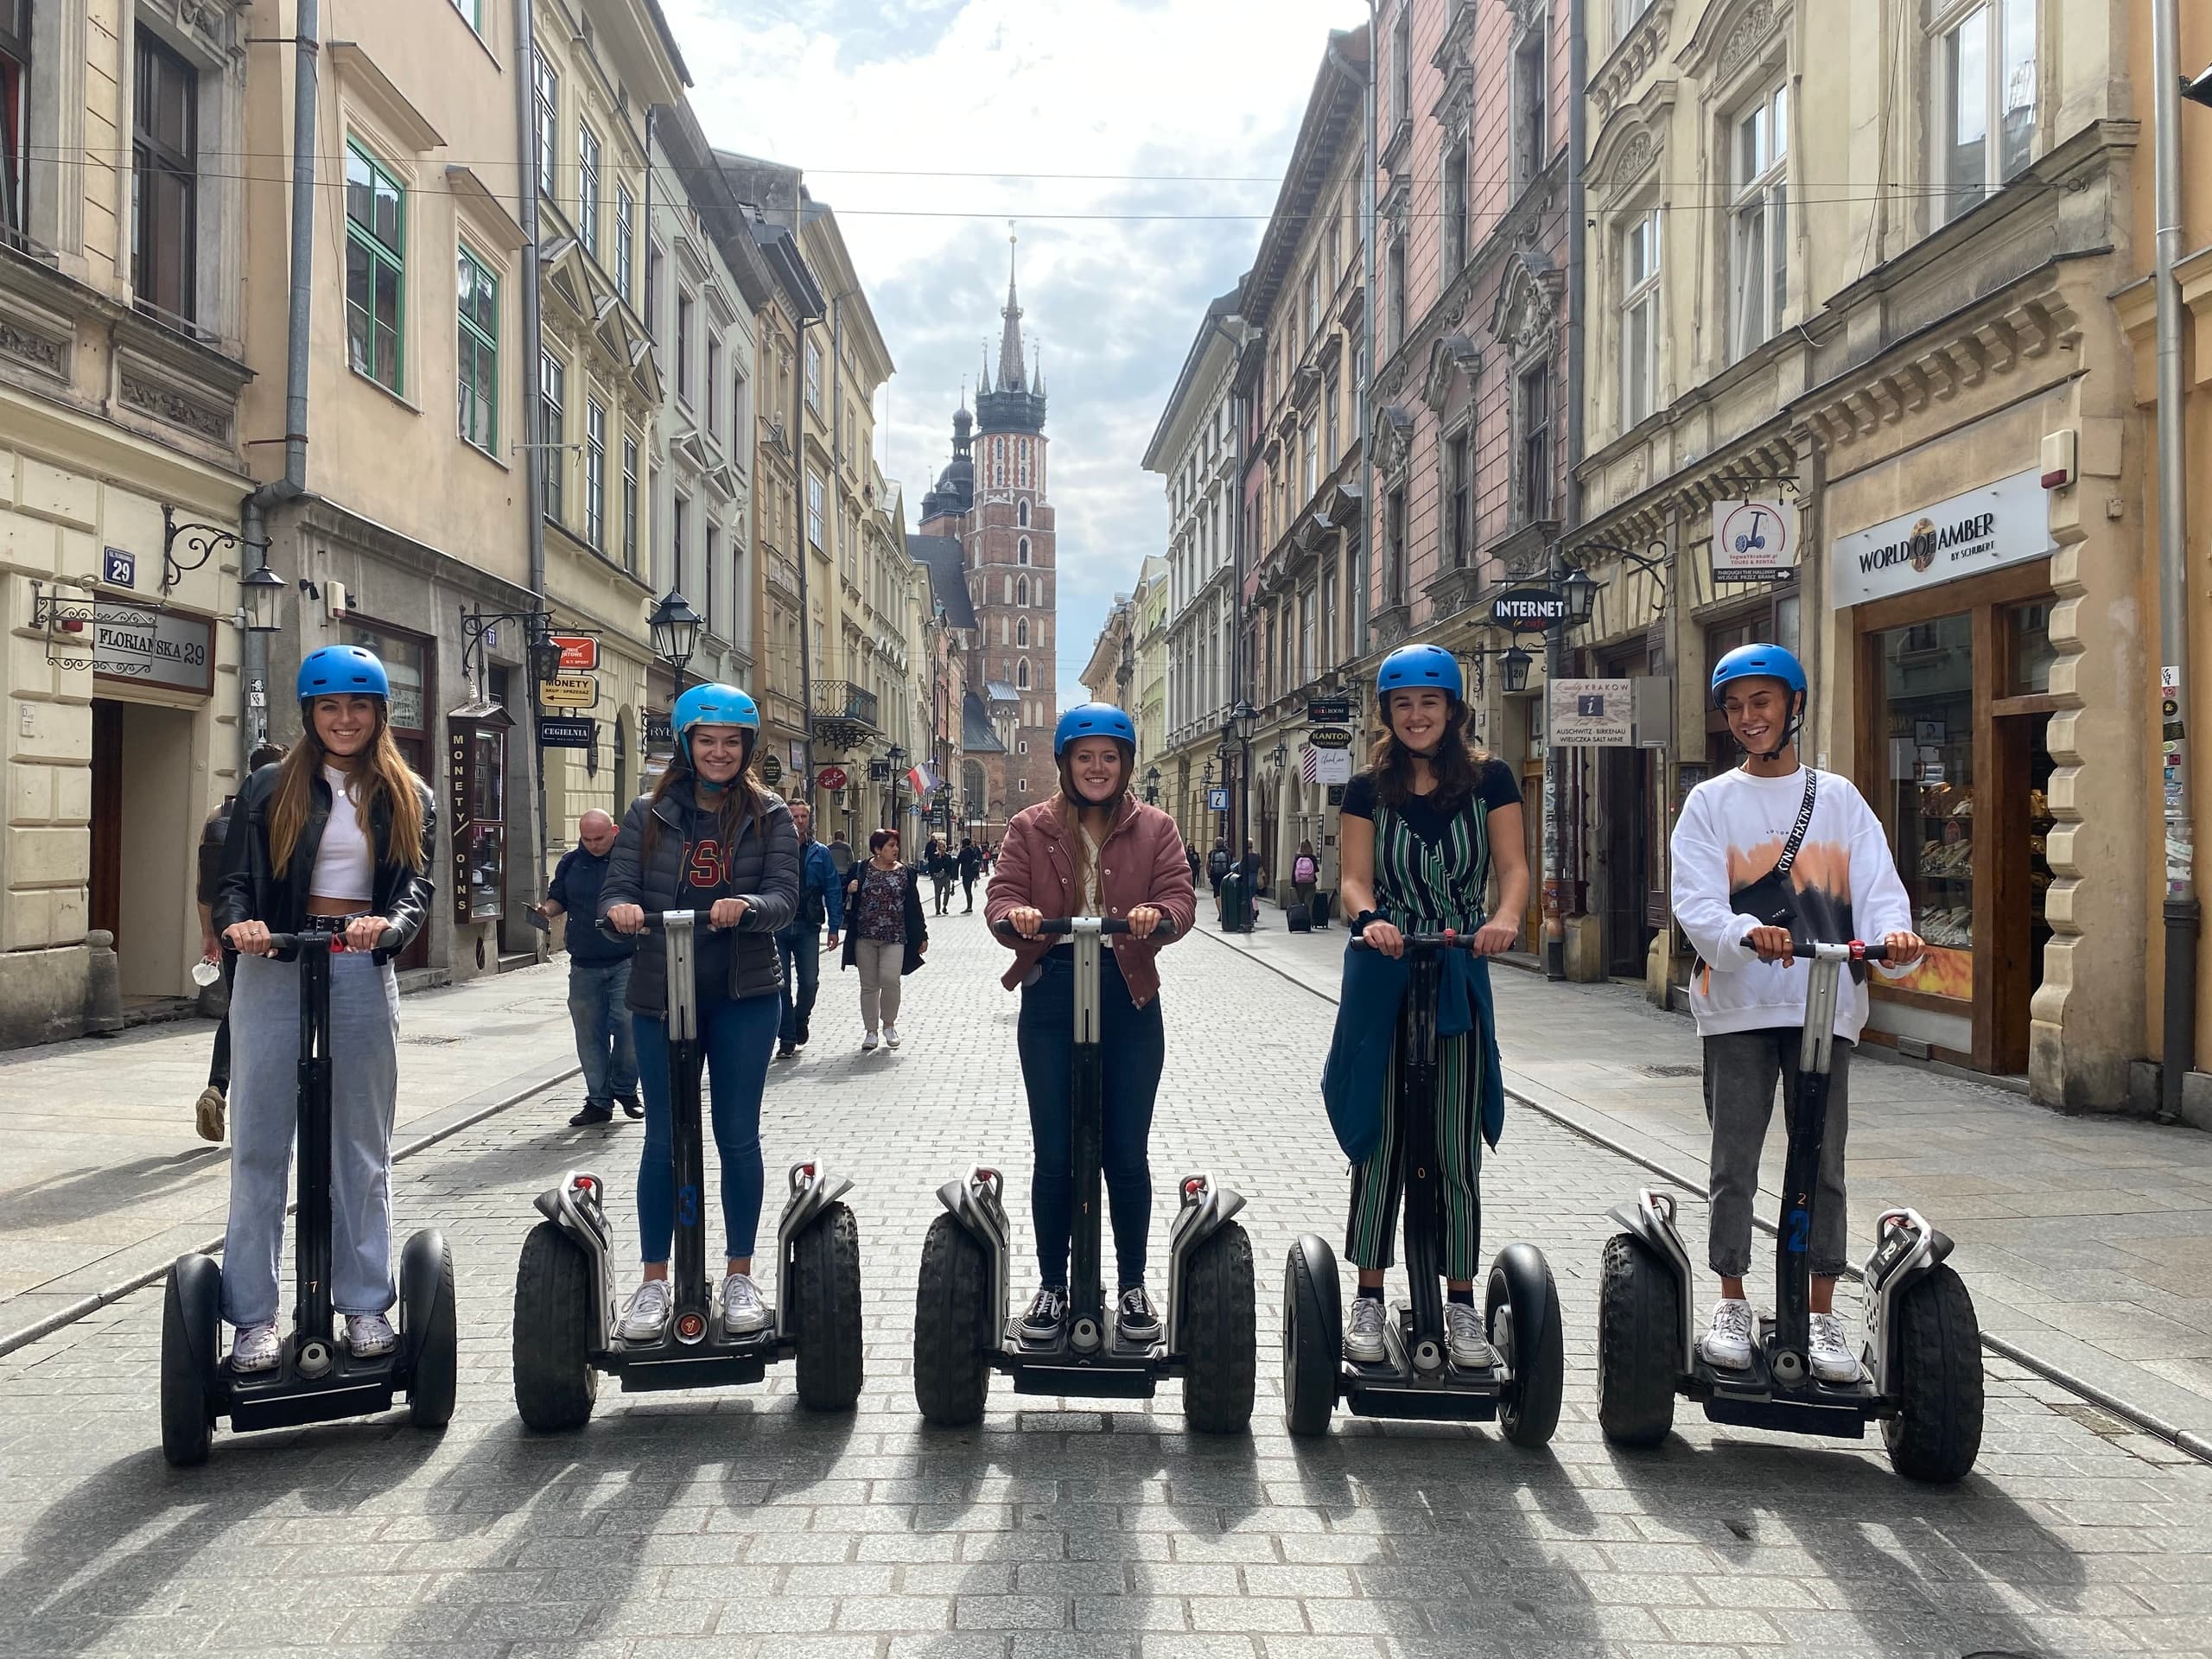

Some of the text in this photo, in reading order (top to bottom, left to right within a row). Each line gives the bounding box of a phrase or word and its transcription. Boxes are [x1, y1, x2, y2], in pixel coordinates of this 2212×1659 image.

[1859, 512, 1994, 574] WORLD OF AMBER
[1950, 540, 1995, 562] BY SCHUBERT
[111, 560, 130, 582] 29
[1496, 601, 1564, 617] INTERNET
[183, 642, 205, 666] 29
[1513, 669, 1523, 678] 20
[545, 679, 588, 689] MONETY
[543, 728, 588, 737] CEGIELNIA
[1313, 732, 1350, 741] KANTOR
[1792, 807, 1813, 839] HXTN
[679, 1184, 697, 1227] 3
[1796, 1192, 1807, 1205] 2
[1788, 1210, 1809, 1252] 2
[309, 1281, 318, 1294] 7
